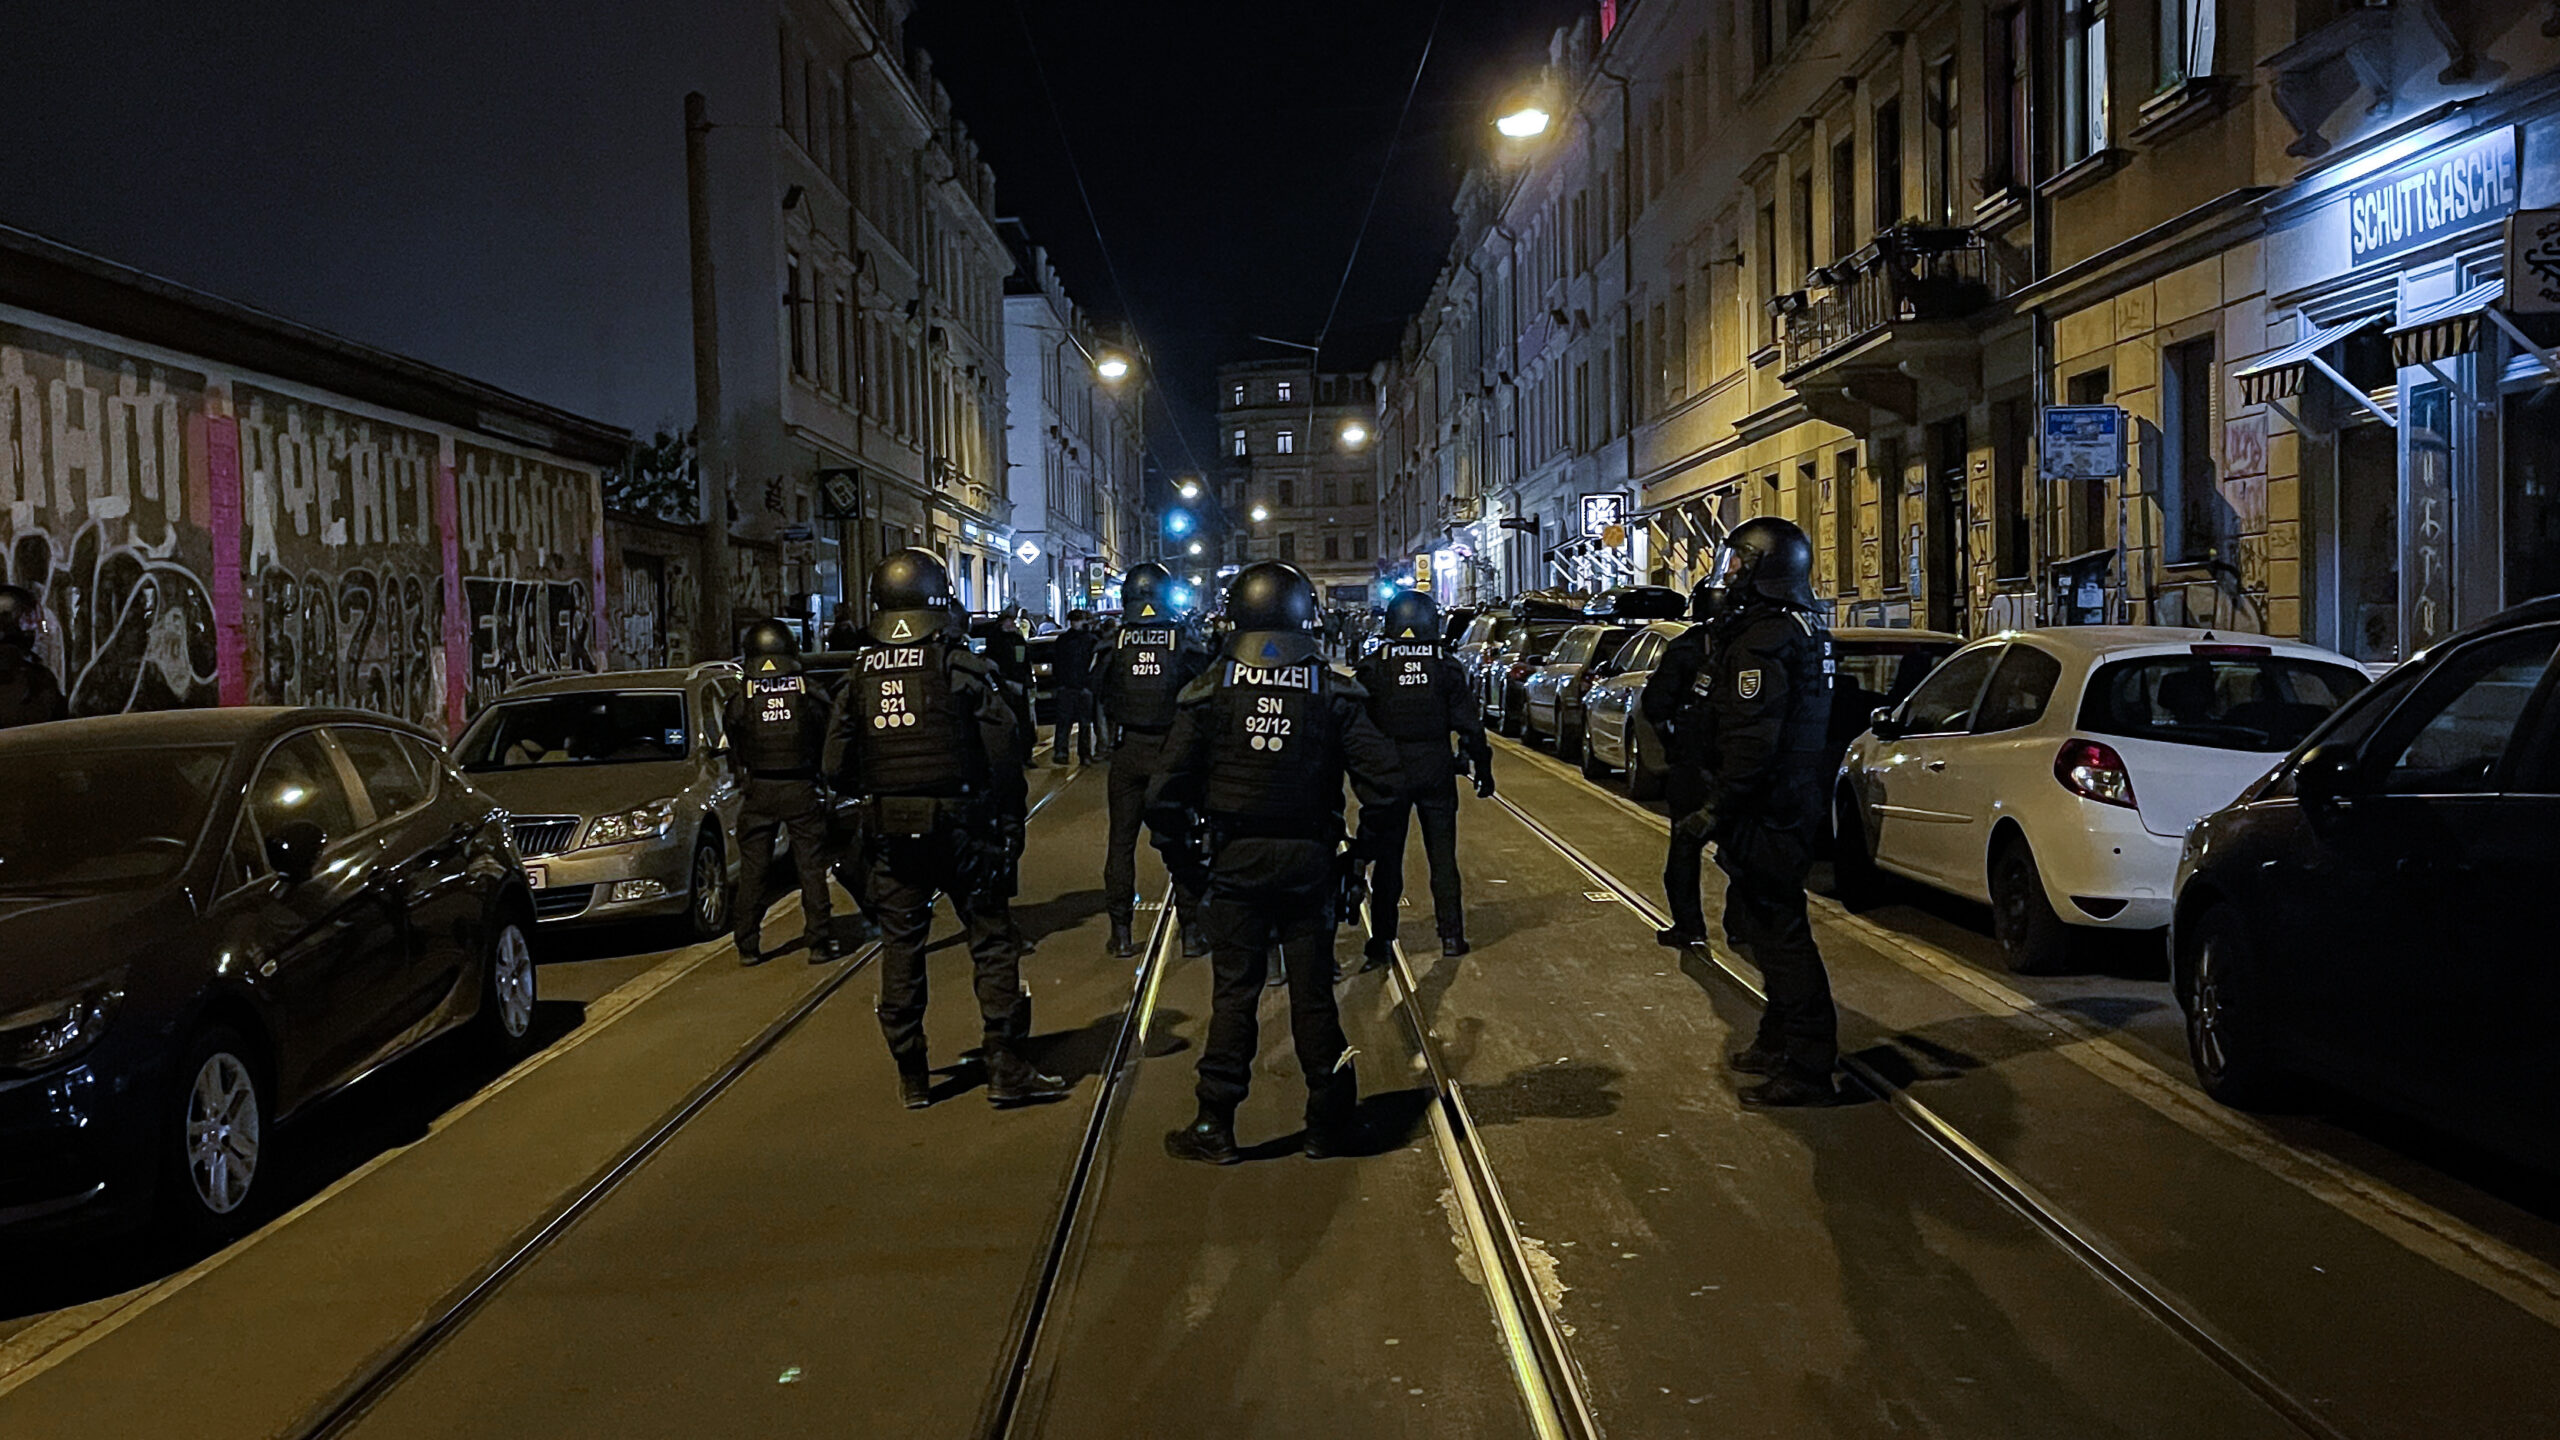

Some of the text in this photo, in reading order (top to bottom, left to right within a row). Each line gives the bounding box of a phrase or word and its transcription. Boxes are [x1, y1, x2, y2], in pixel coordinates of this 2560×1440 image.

[2353, 147, 2515, 255] SCHUTT&ASCHE
[1124, 630, 1169, 645] POLIZEI
[1138, 651, 1155, 663] SN
[1391, 644, 1433, 657] POLIZEI
[863, 648, 924, 672] POLIZEI
[1404, 661, 1422, 673] SN
[1132, 663, 1161, 676] 92/13
[1232, 662, 1309, 689] POLIZEI
[753, 676, 800, 694] POLIZEI
[1398, 672, 1429, 686] 92/13
[881, 679, 904, 696] SN
[767, 697, 784, 709] SN
[880, 696, 906, 714] 921
[1256, 697, 1283, 715] SN
[761, 708, 791, 722] 92/13
[1245, 715, 1291, 735] 92/12
